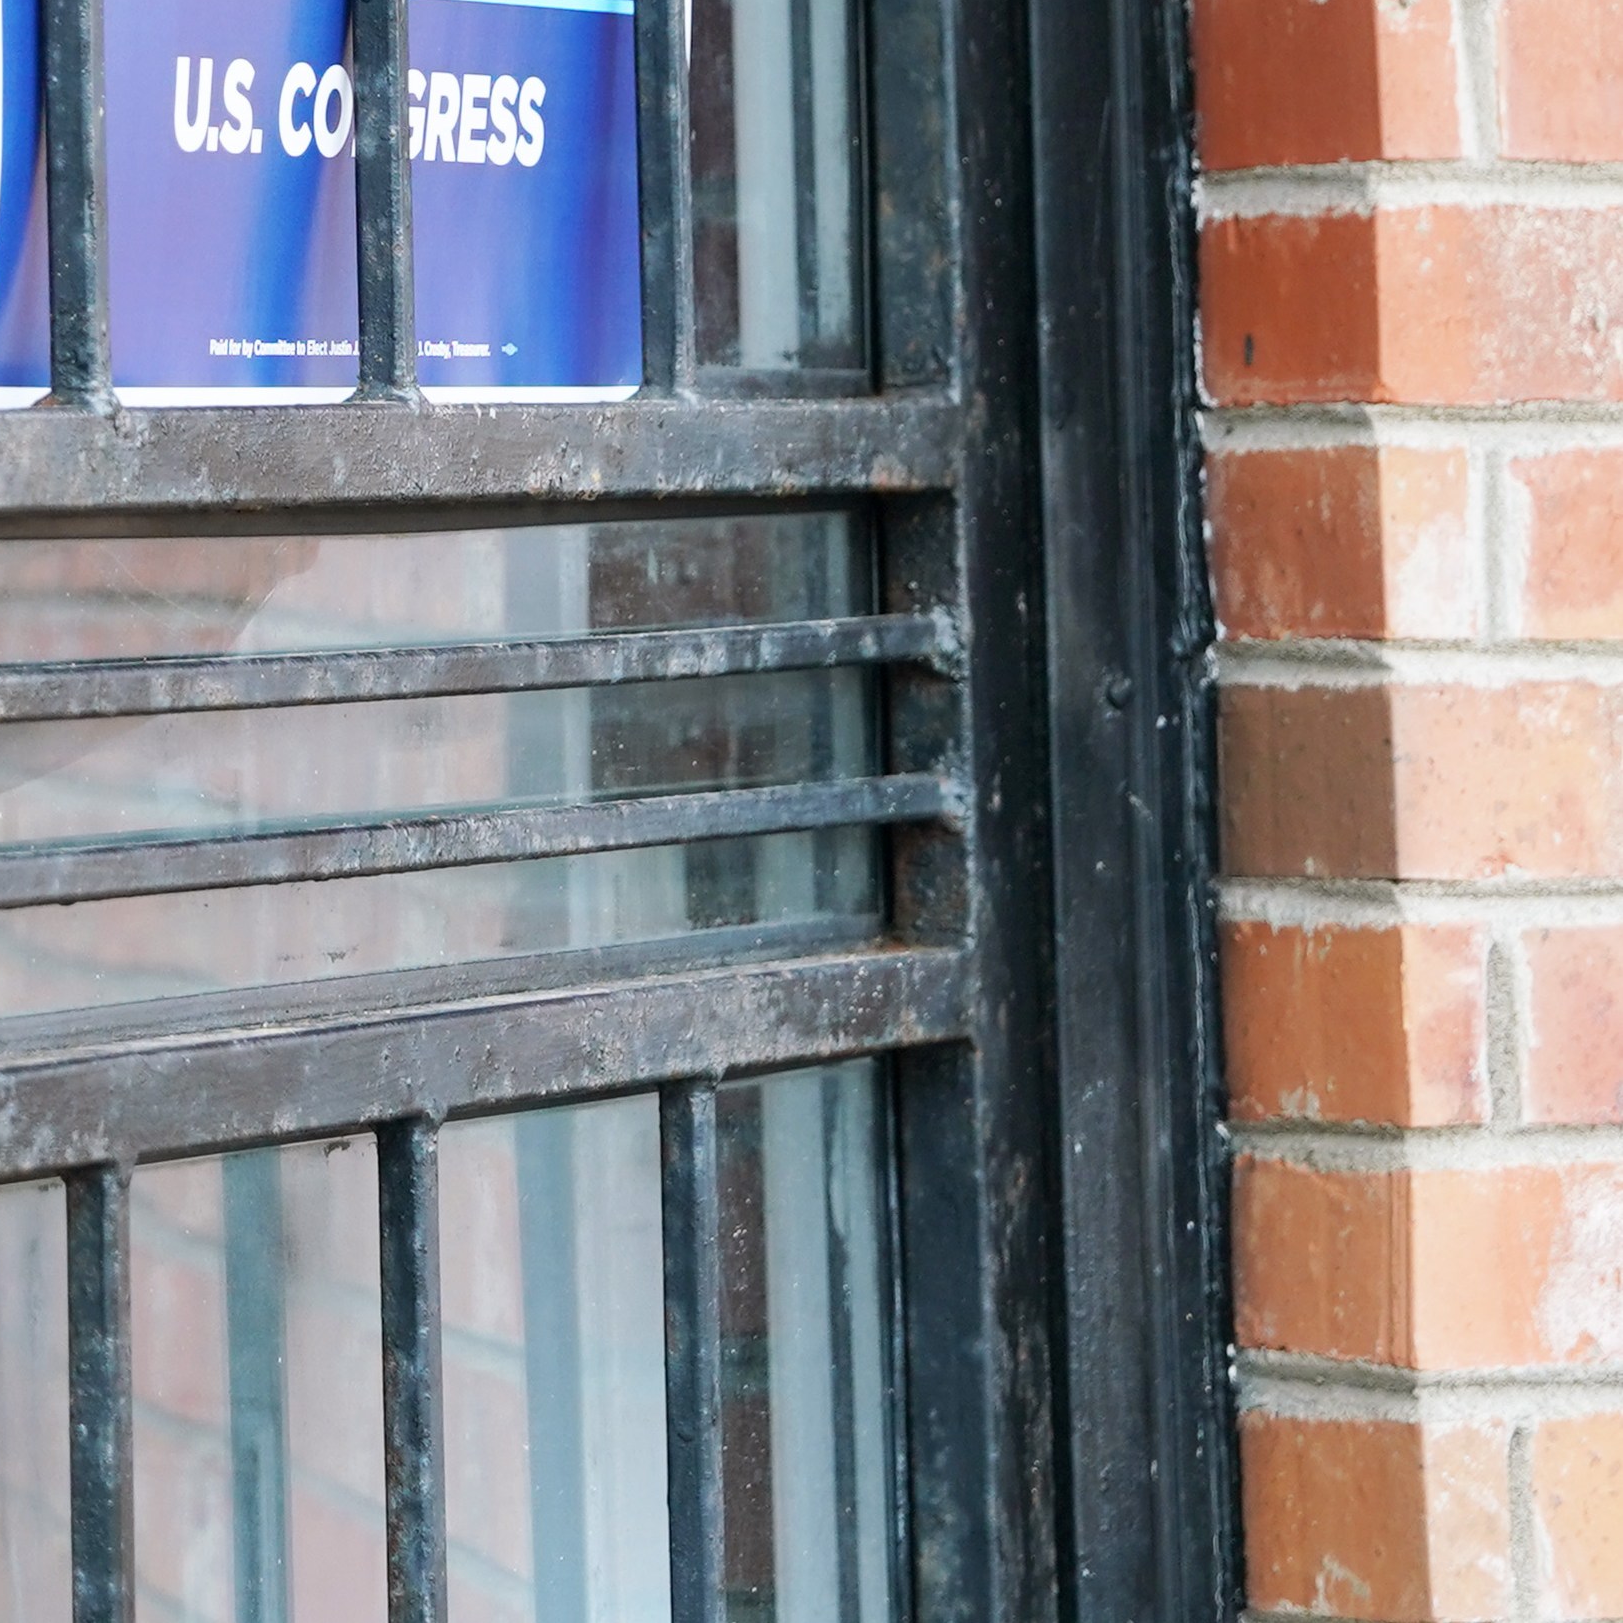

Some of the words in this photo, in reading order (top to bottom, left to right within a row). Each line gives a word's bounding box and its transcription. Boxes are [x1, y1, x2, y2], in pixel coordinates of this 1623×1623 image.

[174, 56, 263, 154] U.S.
[278, 61, 547, 168] COGRESS
[209, 338, 228, 356] Paid
[229, 339, 241, 356] for
[242, 339, 254, 359] by
[254, 339, 296, 356] Committee
[296, 340, 306, 356] to
[307, 339, 328, 356] Elect
[329, 339, 353, 356] Justin
